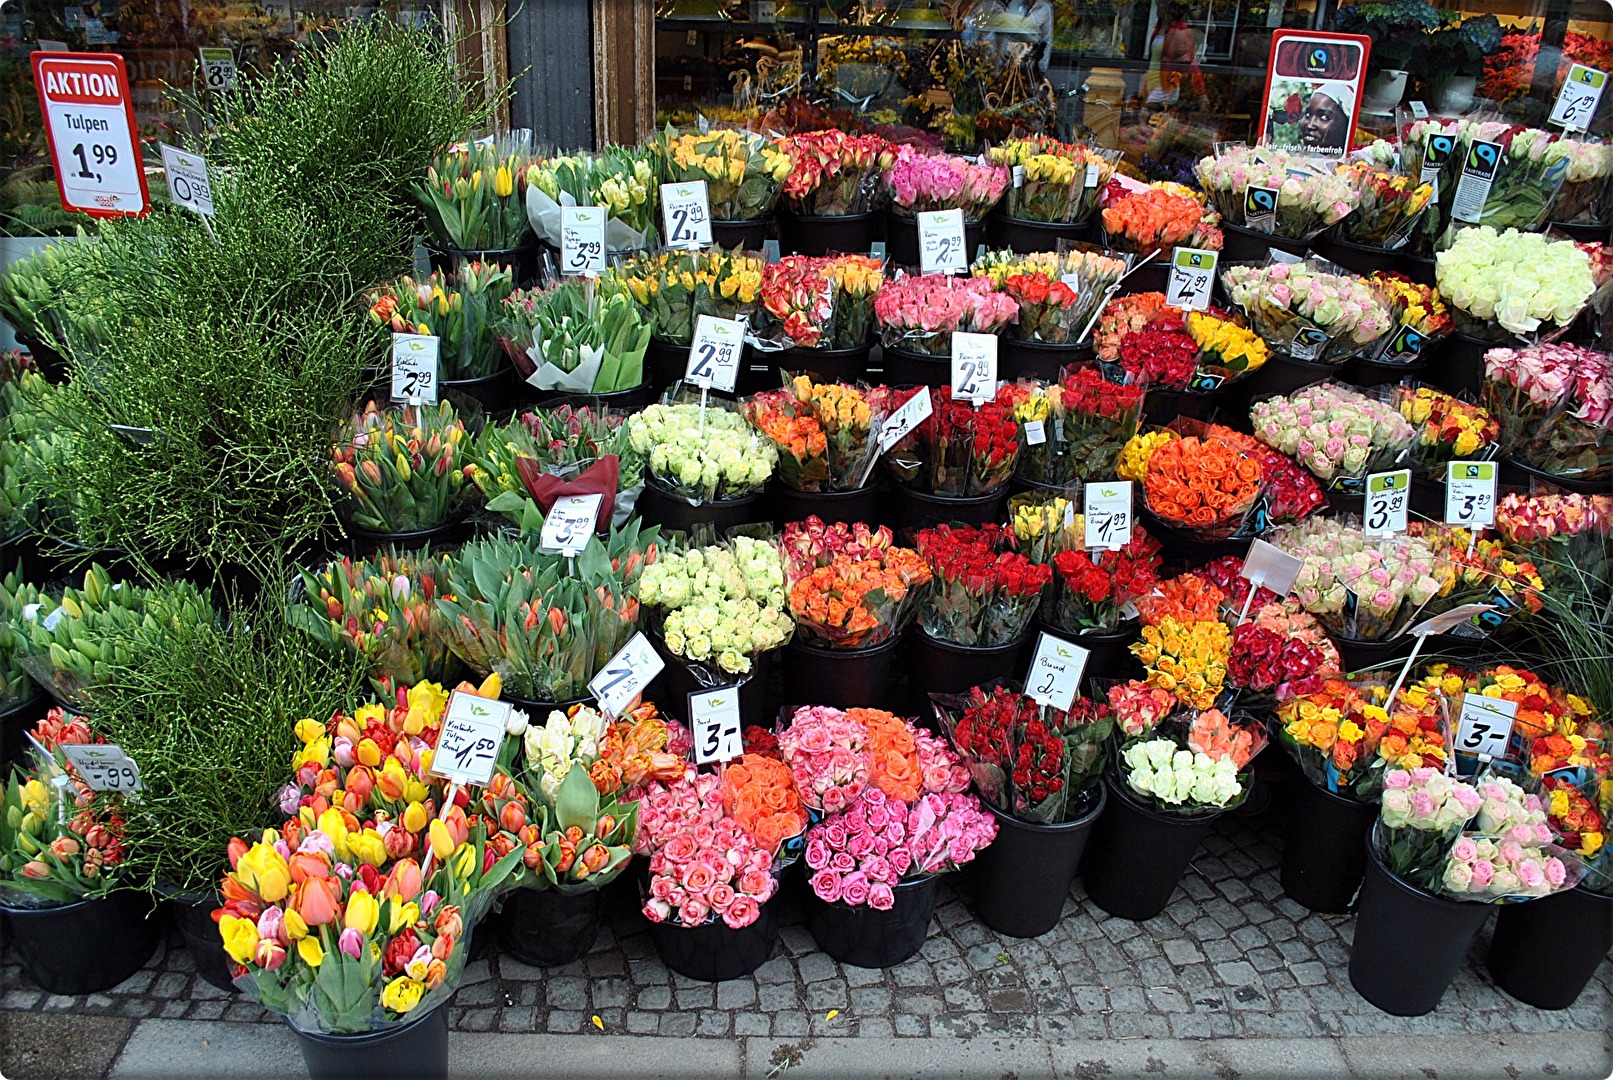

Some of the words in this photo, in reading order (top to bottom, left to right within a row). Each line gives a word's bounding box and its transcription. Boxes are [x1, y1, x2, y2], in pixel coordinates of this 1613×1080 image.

[46, 71, 119, 98] AKTION
[63, 113, 109, 132] Tulpen
[1282, 144, 1302, 152] frisch
[1306, 145, 1343, 155] farbenfroh
[1465, 167, 1491, 178] FAIRTRADE
[1040, 656, 1066, 674] Bund
[696, 717, 711, 726] Bund
[1463, 712, 1479, 722] Bund
[441, 739, 459, 754] Bund
